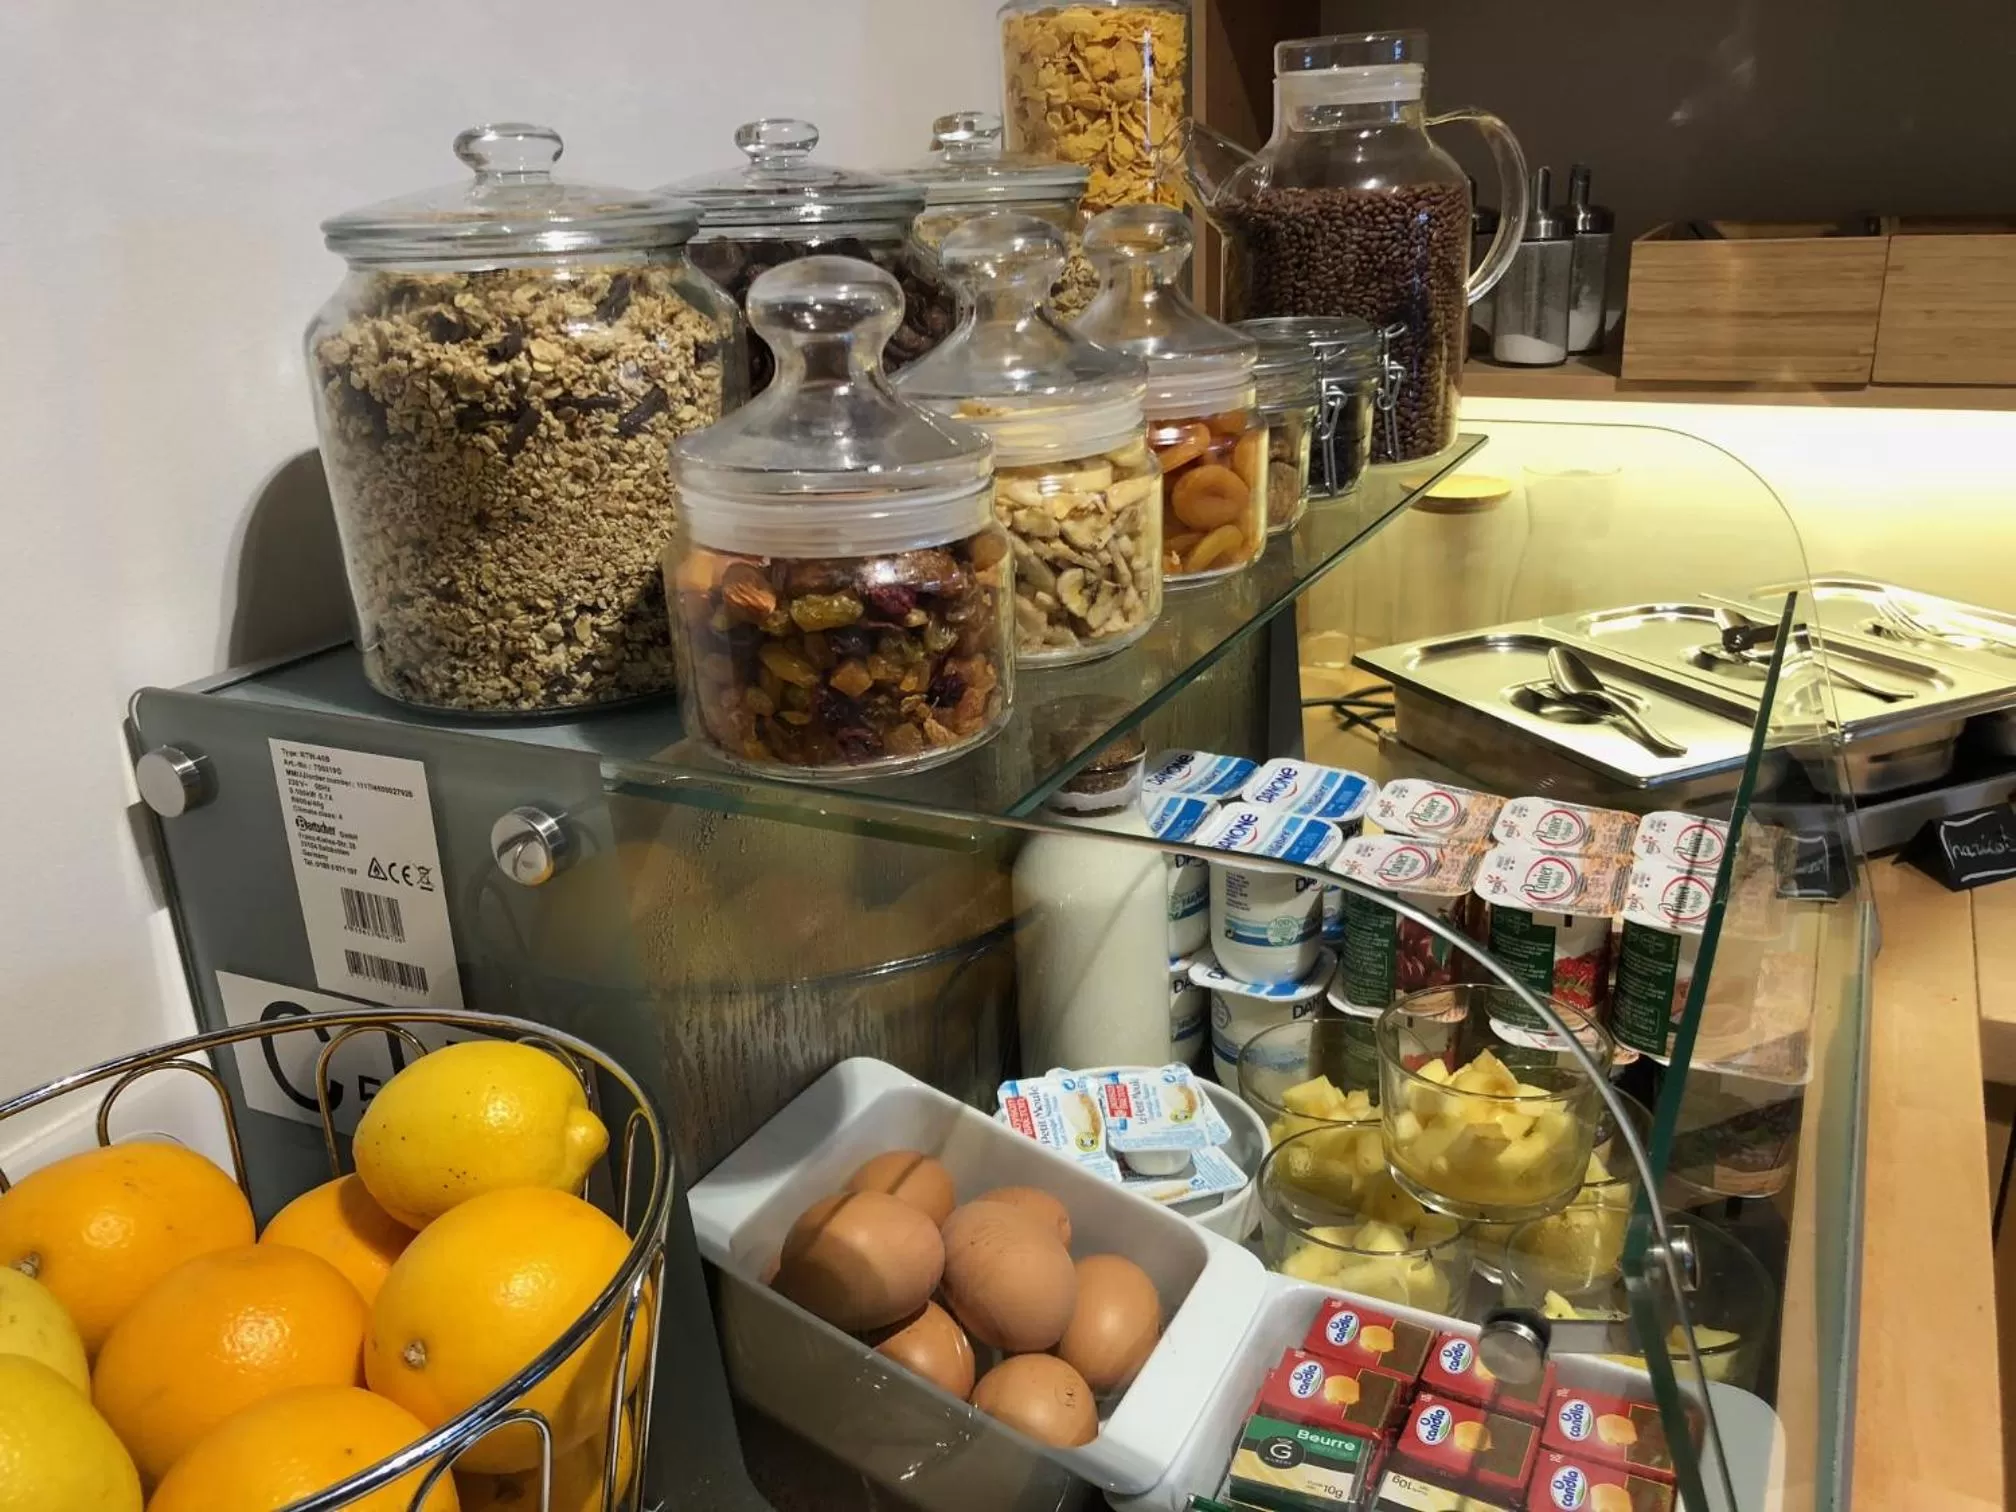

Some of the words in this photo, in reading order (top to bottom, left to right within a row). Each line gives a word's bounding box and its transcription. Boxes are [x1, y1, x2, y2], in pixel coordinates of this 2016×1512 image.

[1147, 754, 1195, 785] DANONE
[1256, 765, 1298, 803] DANONE
[1520, 864, 1553, 894] Panier
[1334, 1314, 1354, 1344] candia
[1448, 1342, 1467, 1372] candia
[1297, 1363, 1318, 1396] candia
[1426, 1408, 1446, 1442] candia
[1569, 1403, 1585, 1438] candia
[1297, 1429, 1356, 1452] Beurre
[1323, 1484, 1344, 1499] 10g
[1391, 1475, 1413, 1491] 10g
[1562, 1470, 1580, 1507] candia
